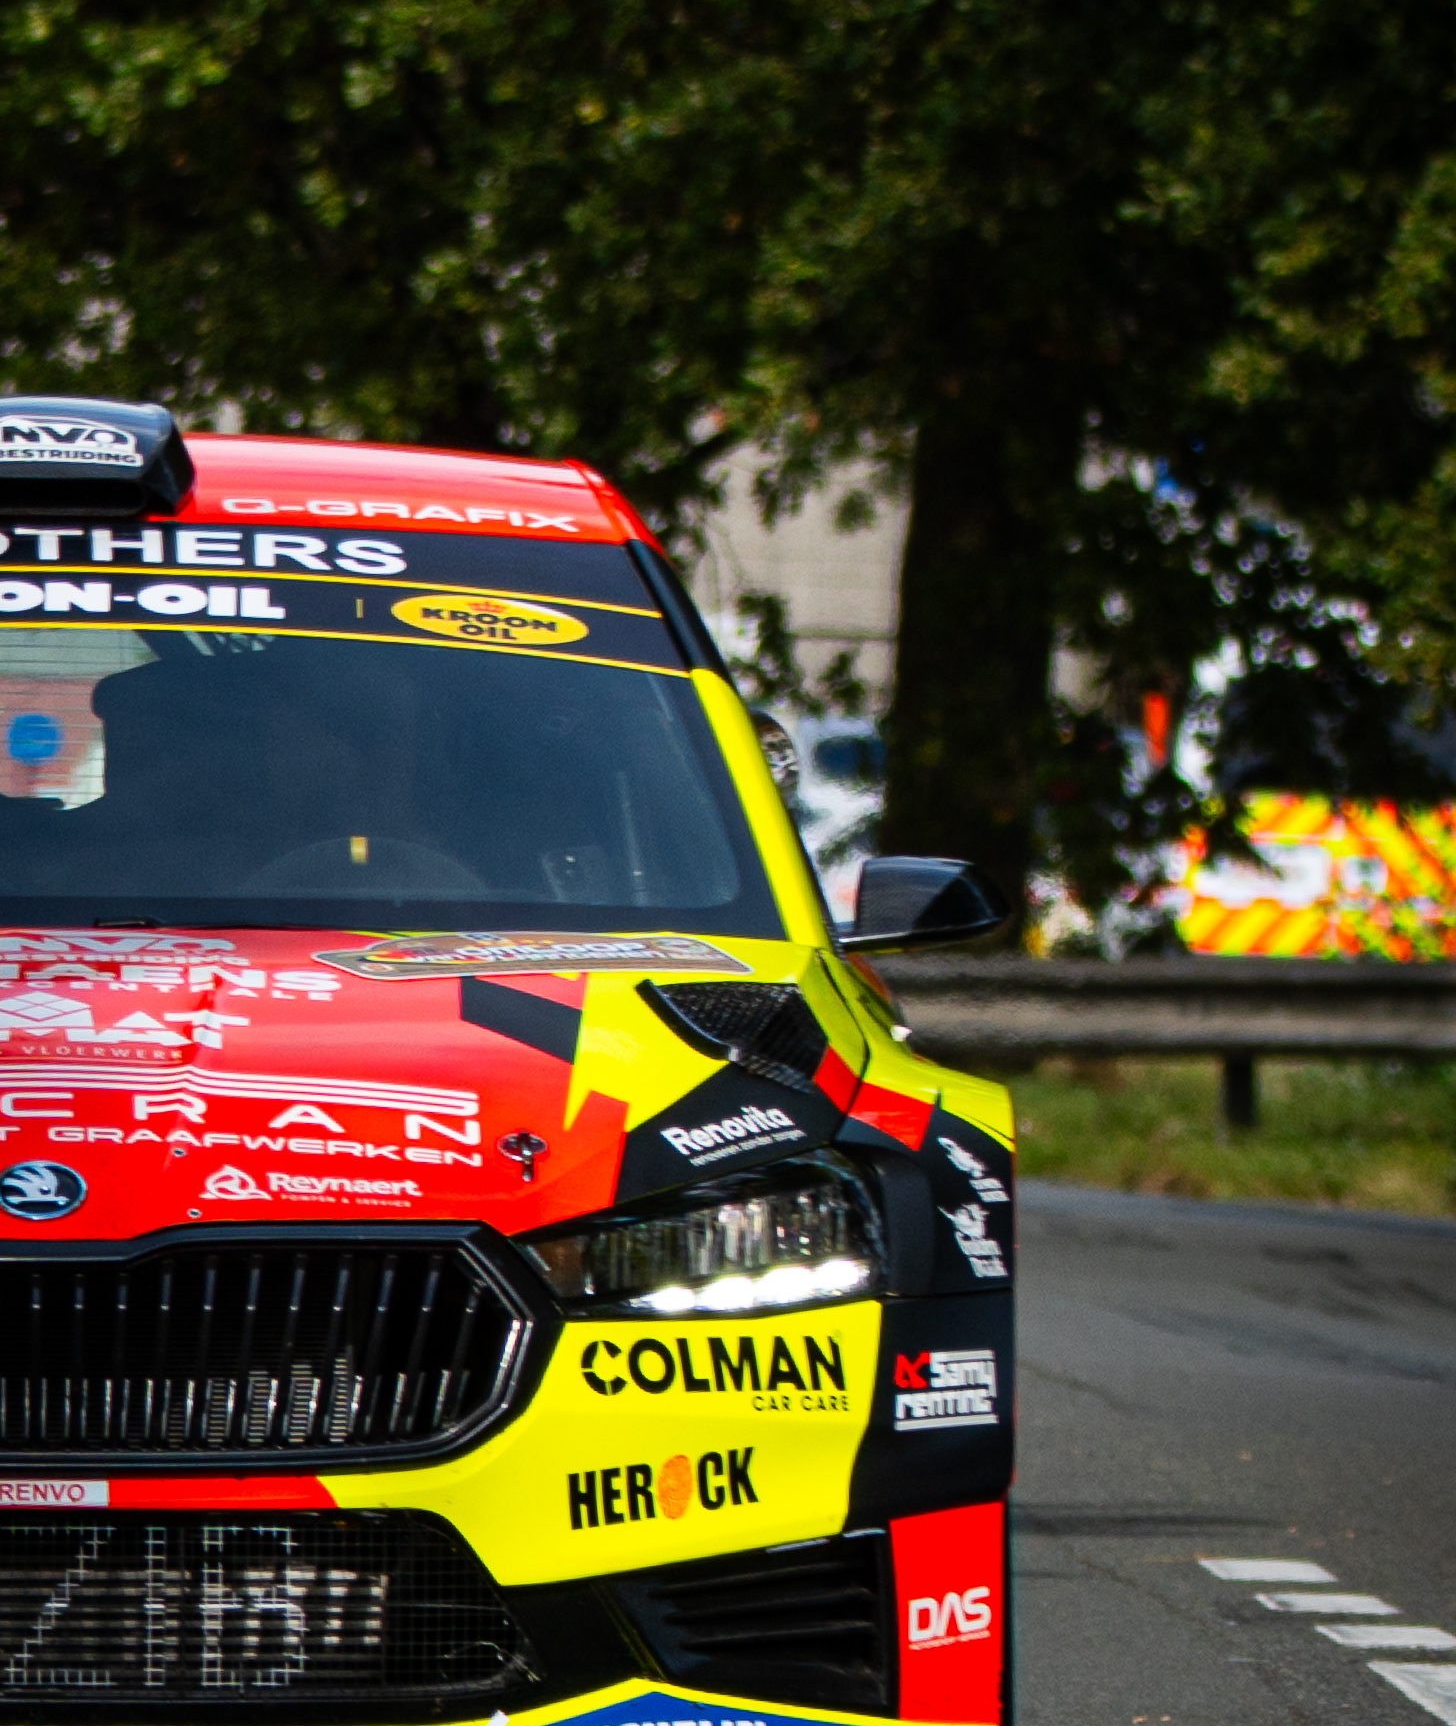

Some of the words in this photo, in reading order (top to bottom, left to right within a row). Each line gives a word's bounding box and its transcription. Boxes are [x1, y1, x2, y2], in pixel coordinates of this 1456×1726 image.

[222, 496, 580, 533] Q-GRAFIX
[419, 607, 558, 634] KROON
[458, 623, 520, 641] OIL
[48, 1126, 483, 1168] GRAAFWERKEN
[660, 1105, 796, 1156] Renovita
[266, 1172, 423, 1197] Reynaert
[581, 1335, 847, 1396] COLMAN
[752, 1394, 793, 1412] CAR
[800, 1394, 850, 1412] CARE
[908, 1585, 992, 1643] DAS
